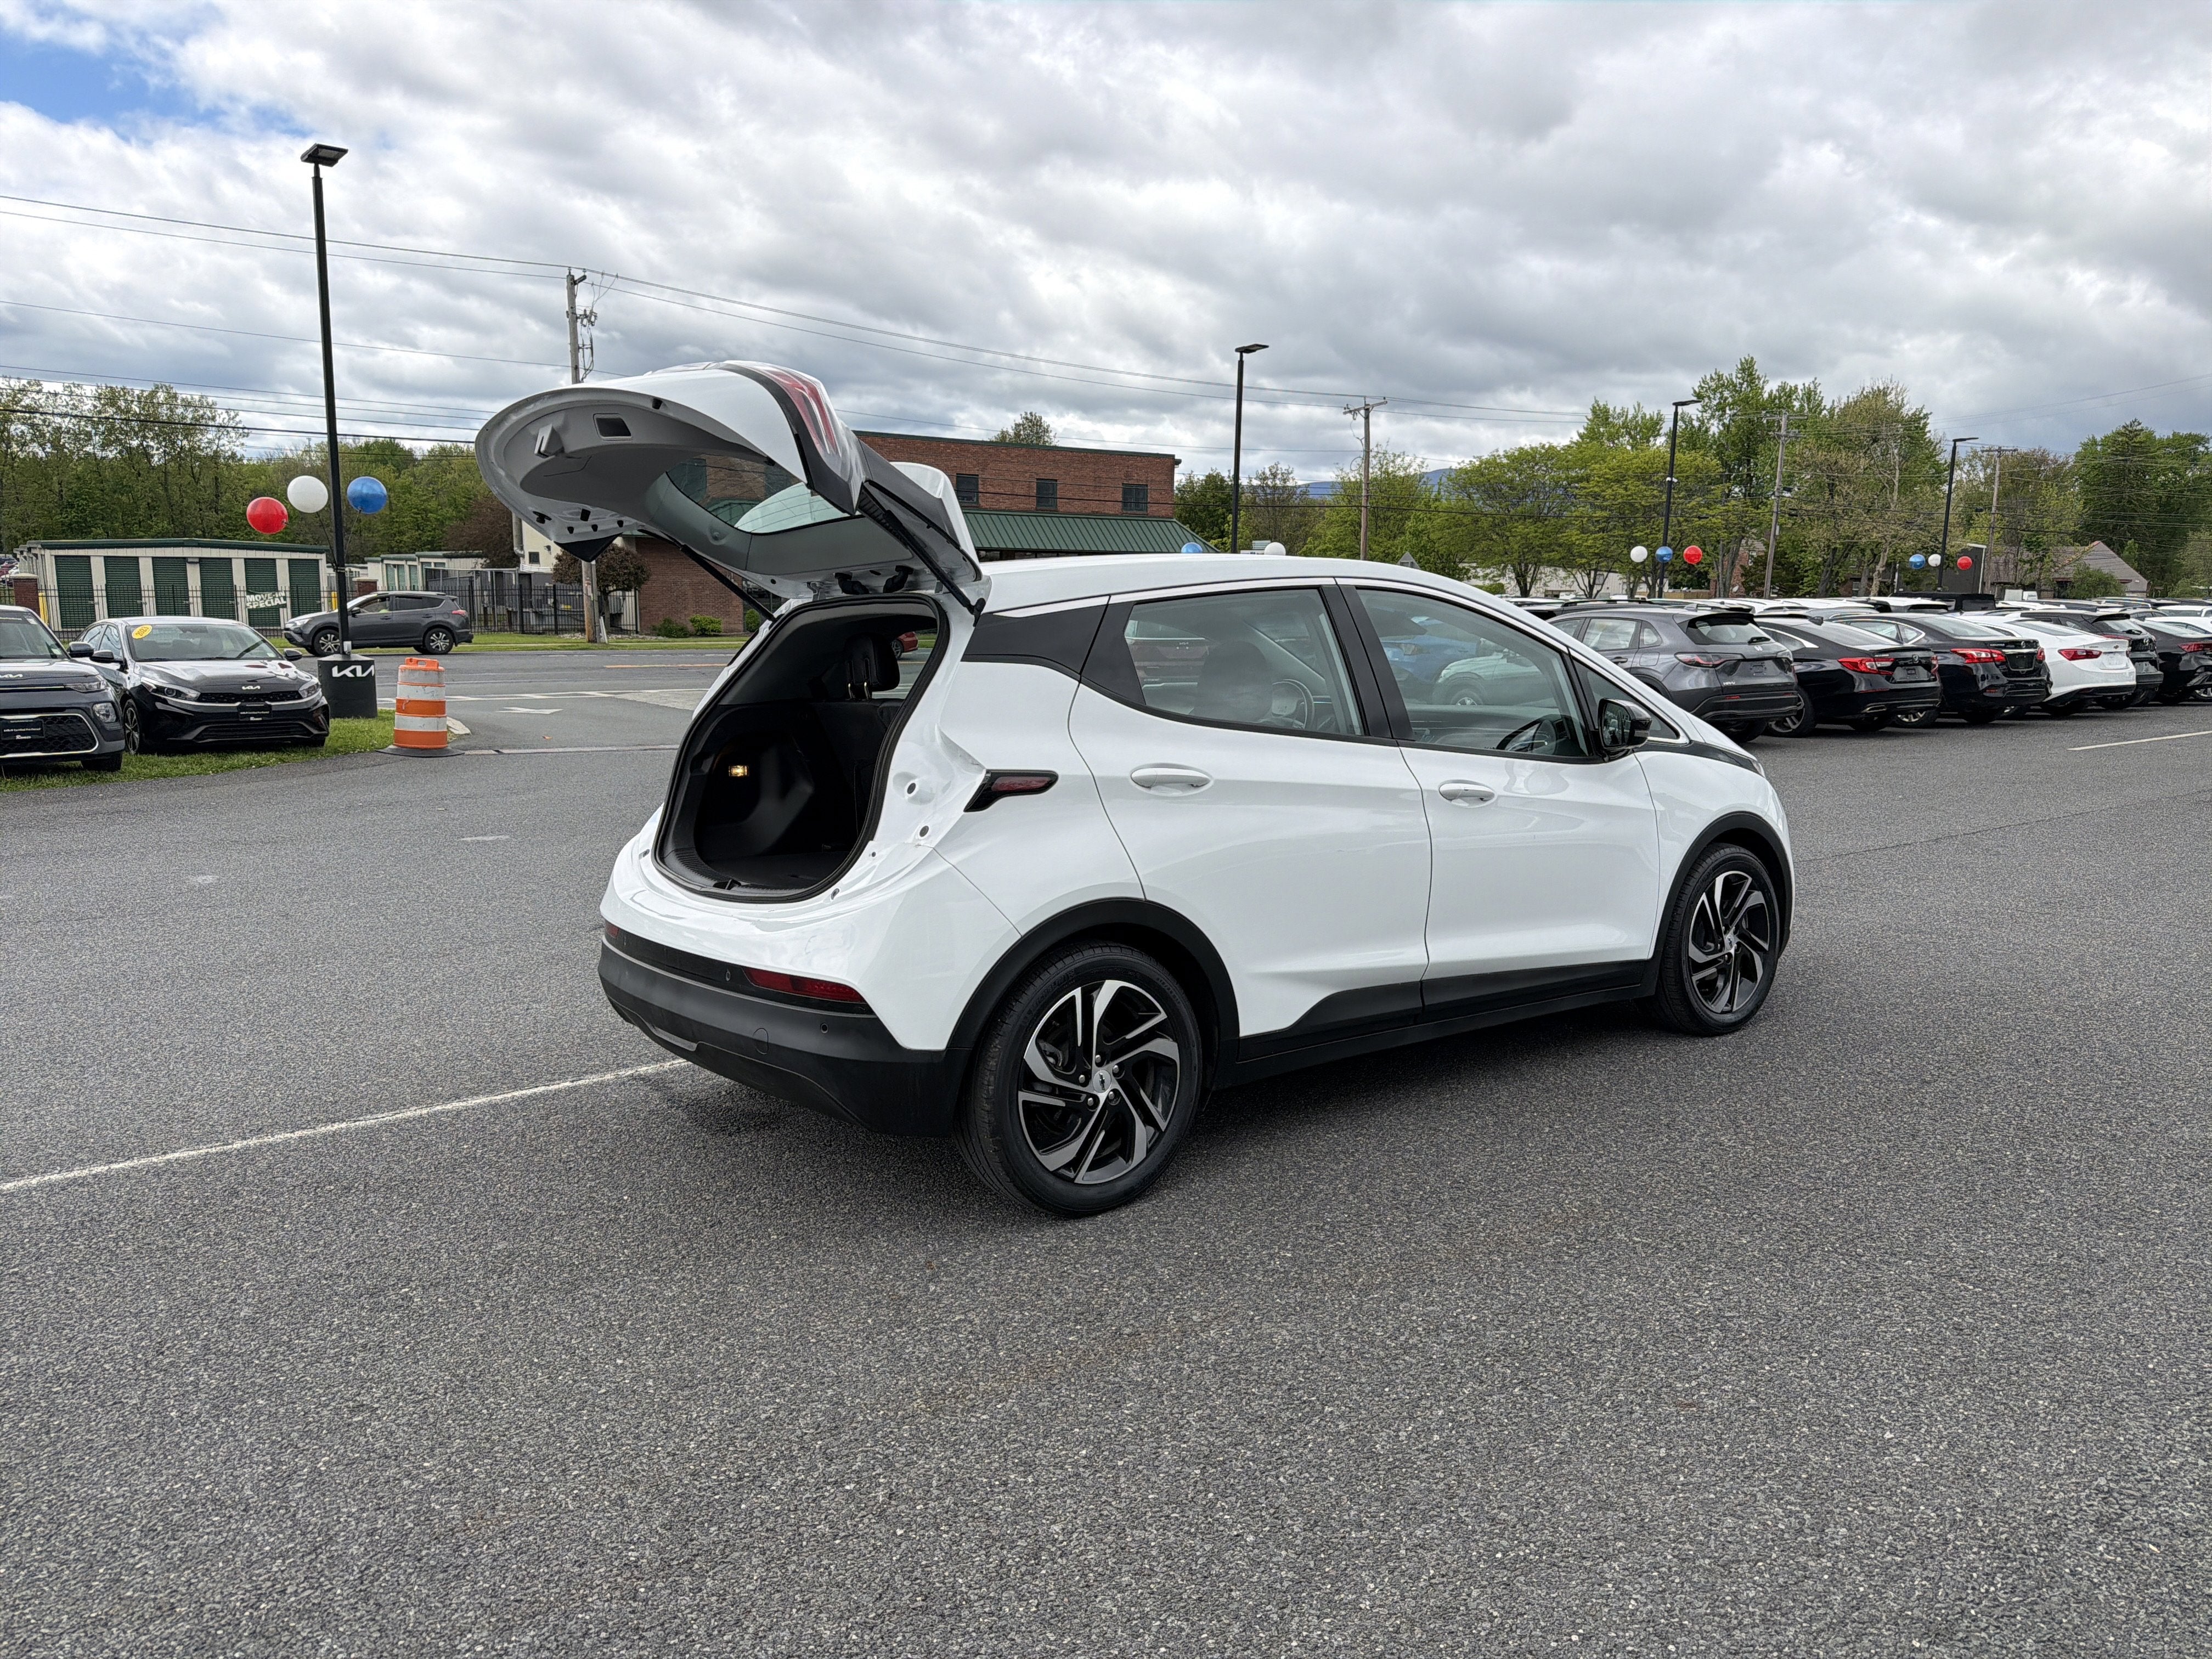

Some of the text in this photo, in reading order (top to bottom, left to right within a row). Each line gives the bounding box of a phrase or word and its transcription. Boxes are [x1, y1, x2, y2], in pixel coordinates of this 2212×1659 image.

[246, 591, 285, 602] MOVE-IN
[246, 597, 286, 608] SPECIAL
[332, 665, 374, 678] KIA
